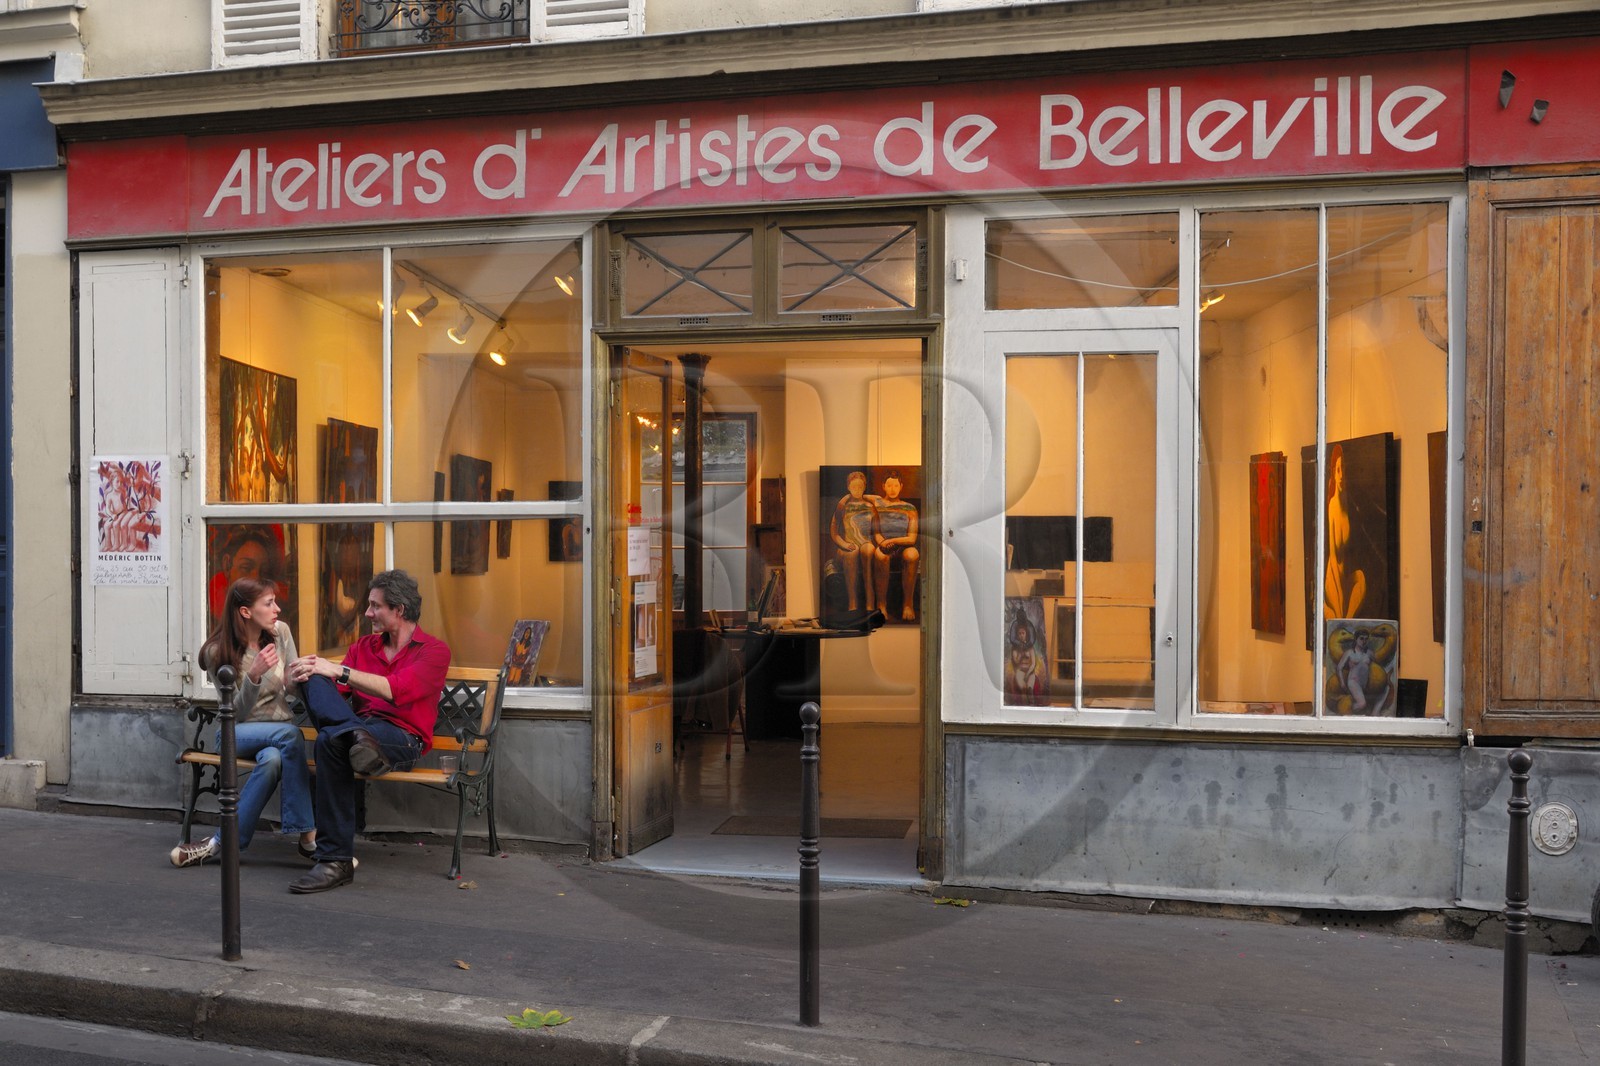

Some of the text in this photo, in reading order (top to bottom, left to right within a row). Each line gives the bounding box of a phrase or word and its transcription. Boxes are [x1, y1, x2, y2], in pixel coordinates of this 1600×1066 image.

[202, 142, 447, 218] Ateliers
[558, 113, 842, 197] Artistes
[873, 101, 998, 177] de
[1038, 75, 1447, 171] Belleville
